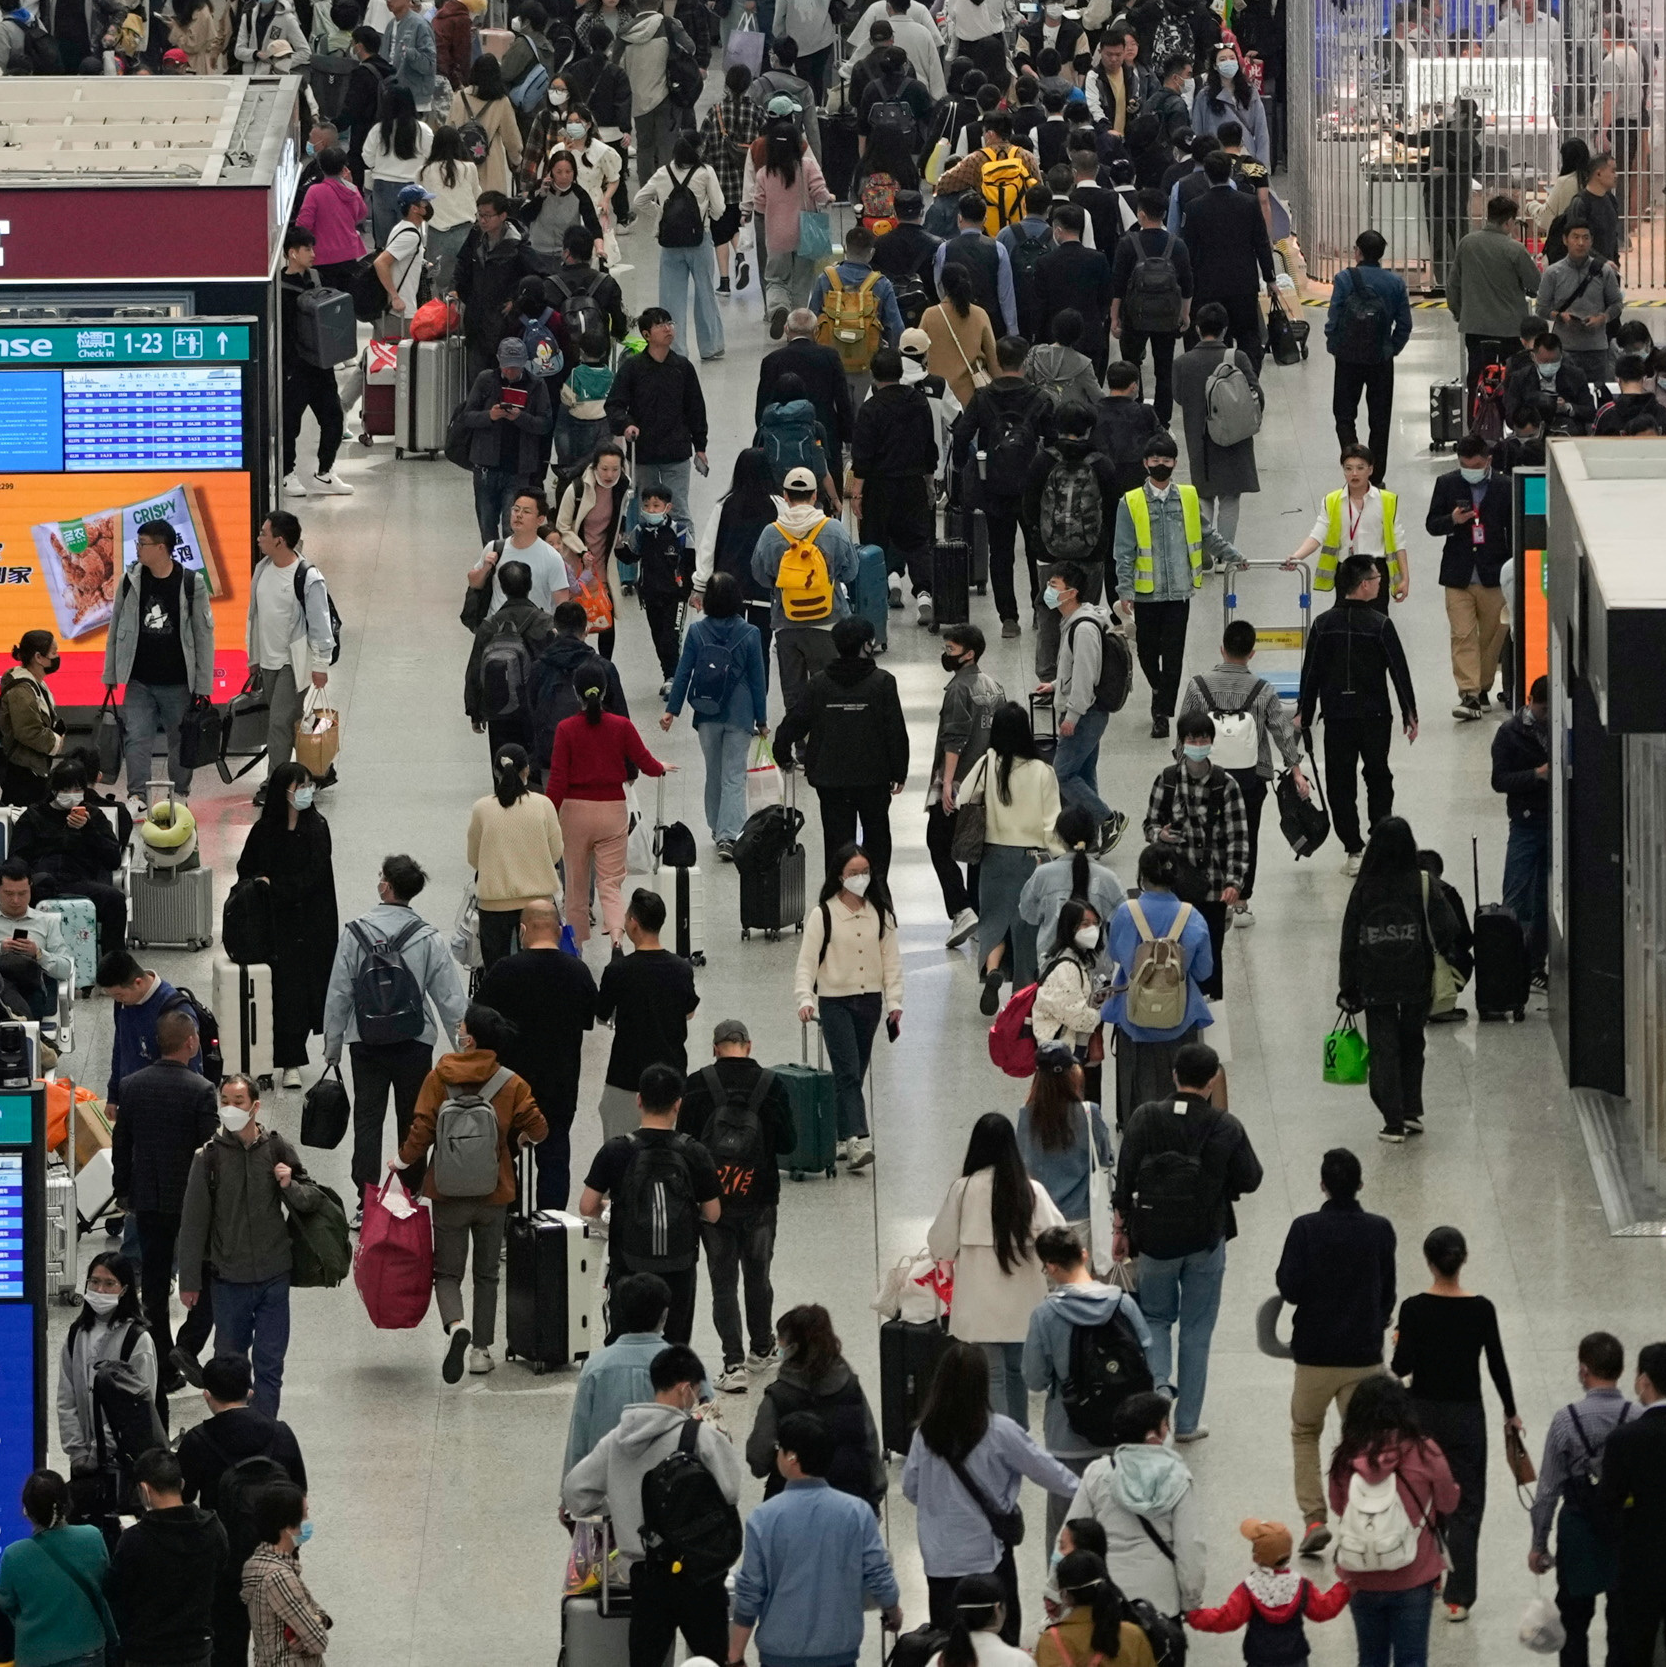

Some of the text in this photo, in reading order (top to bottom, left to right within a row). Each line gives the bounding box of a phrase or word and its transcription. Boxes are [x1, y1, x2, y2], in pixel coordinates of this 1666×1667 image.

[76, 331, 116, 349] 检票口
[123, 333, 164, 355] 1-23
[77, 349, 115, 359] Check in
[132, 498, 177, 526] CRISPY
[62, 527, 86, 542] 圣农
